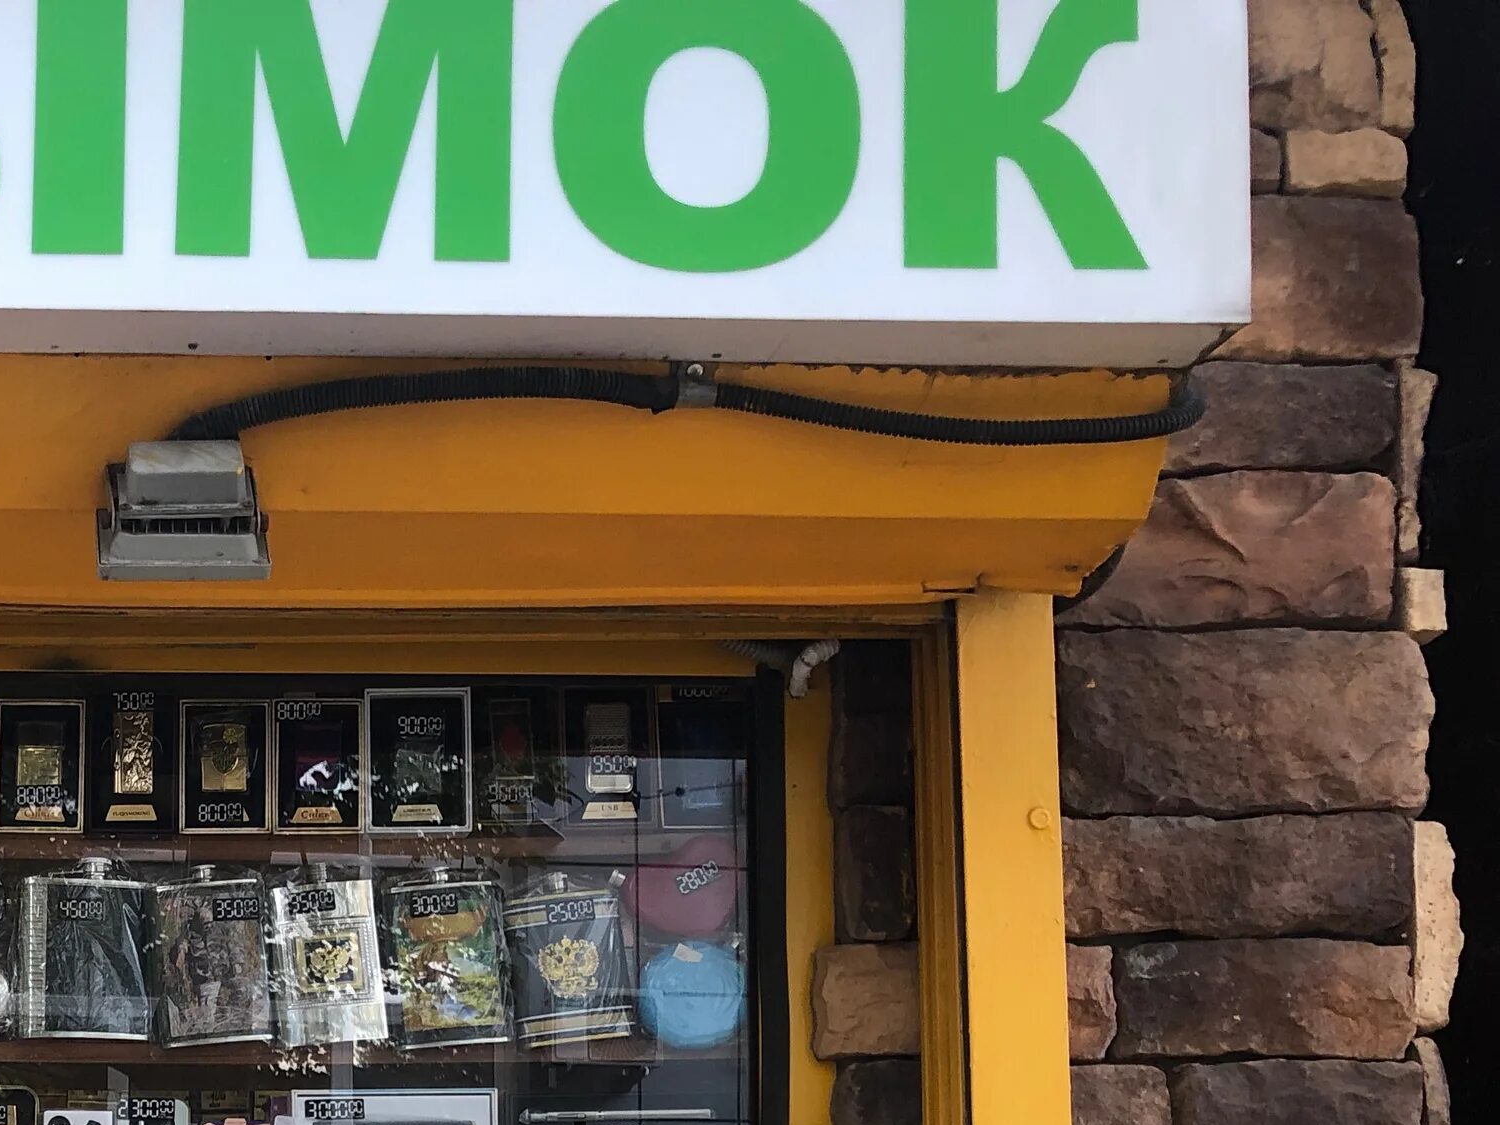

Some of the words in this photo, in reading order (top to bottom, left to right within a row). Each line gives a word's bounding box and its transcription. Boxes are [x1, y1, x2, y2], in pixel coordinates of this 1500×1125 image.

[112, 692, 154, 710] 75000
[277, 702, 321, 720] 80000
[398, 716, 442, 734] 90000
[60, 900, 102, 919] 45000
[216, 899, 258, 918] 35000
[412, 893, 456, 915] 30000
[549, 900, 593, 922] 25000
[307, 1100, 364, 1119] 300000
